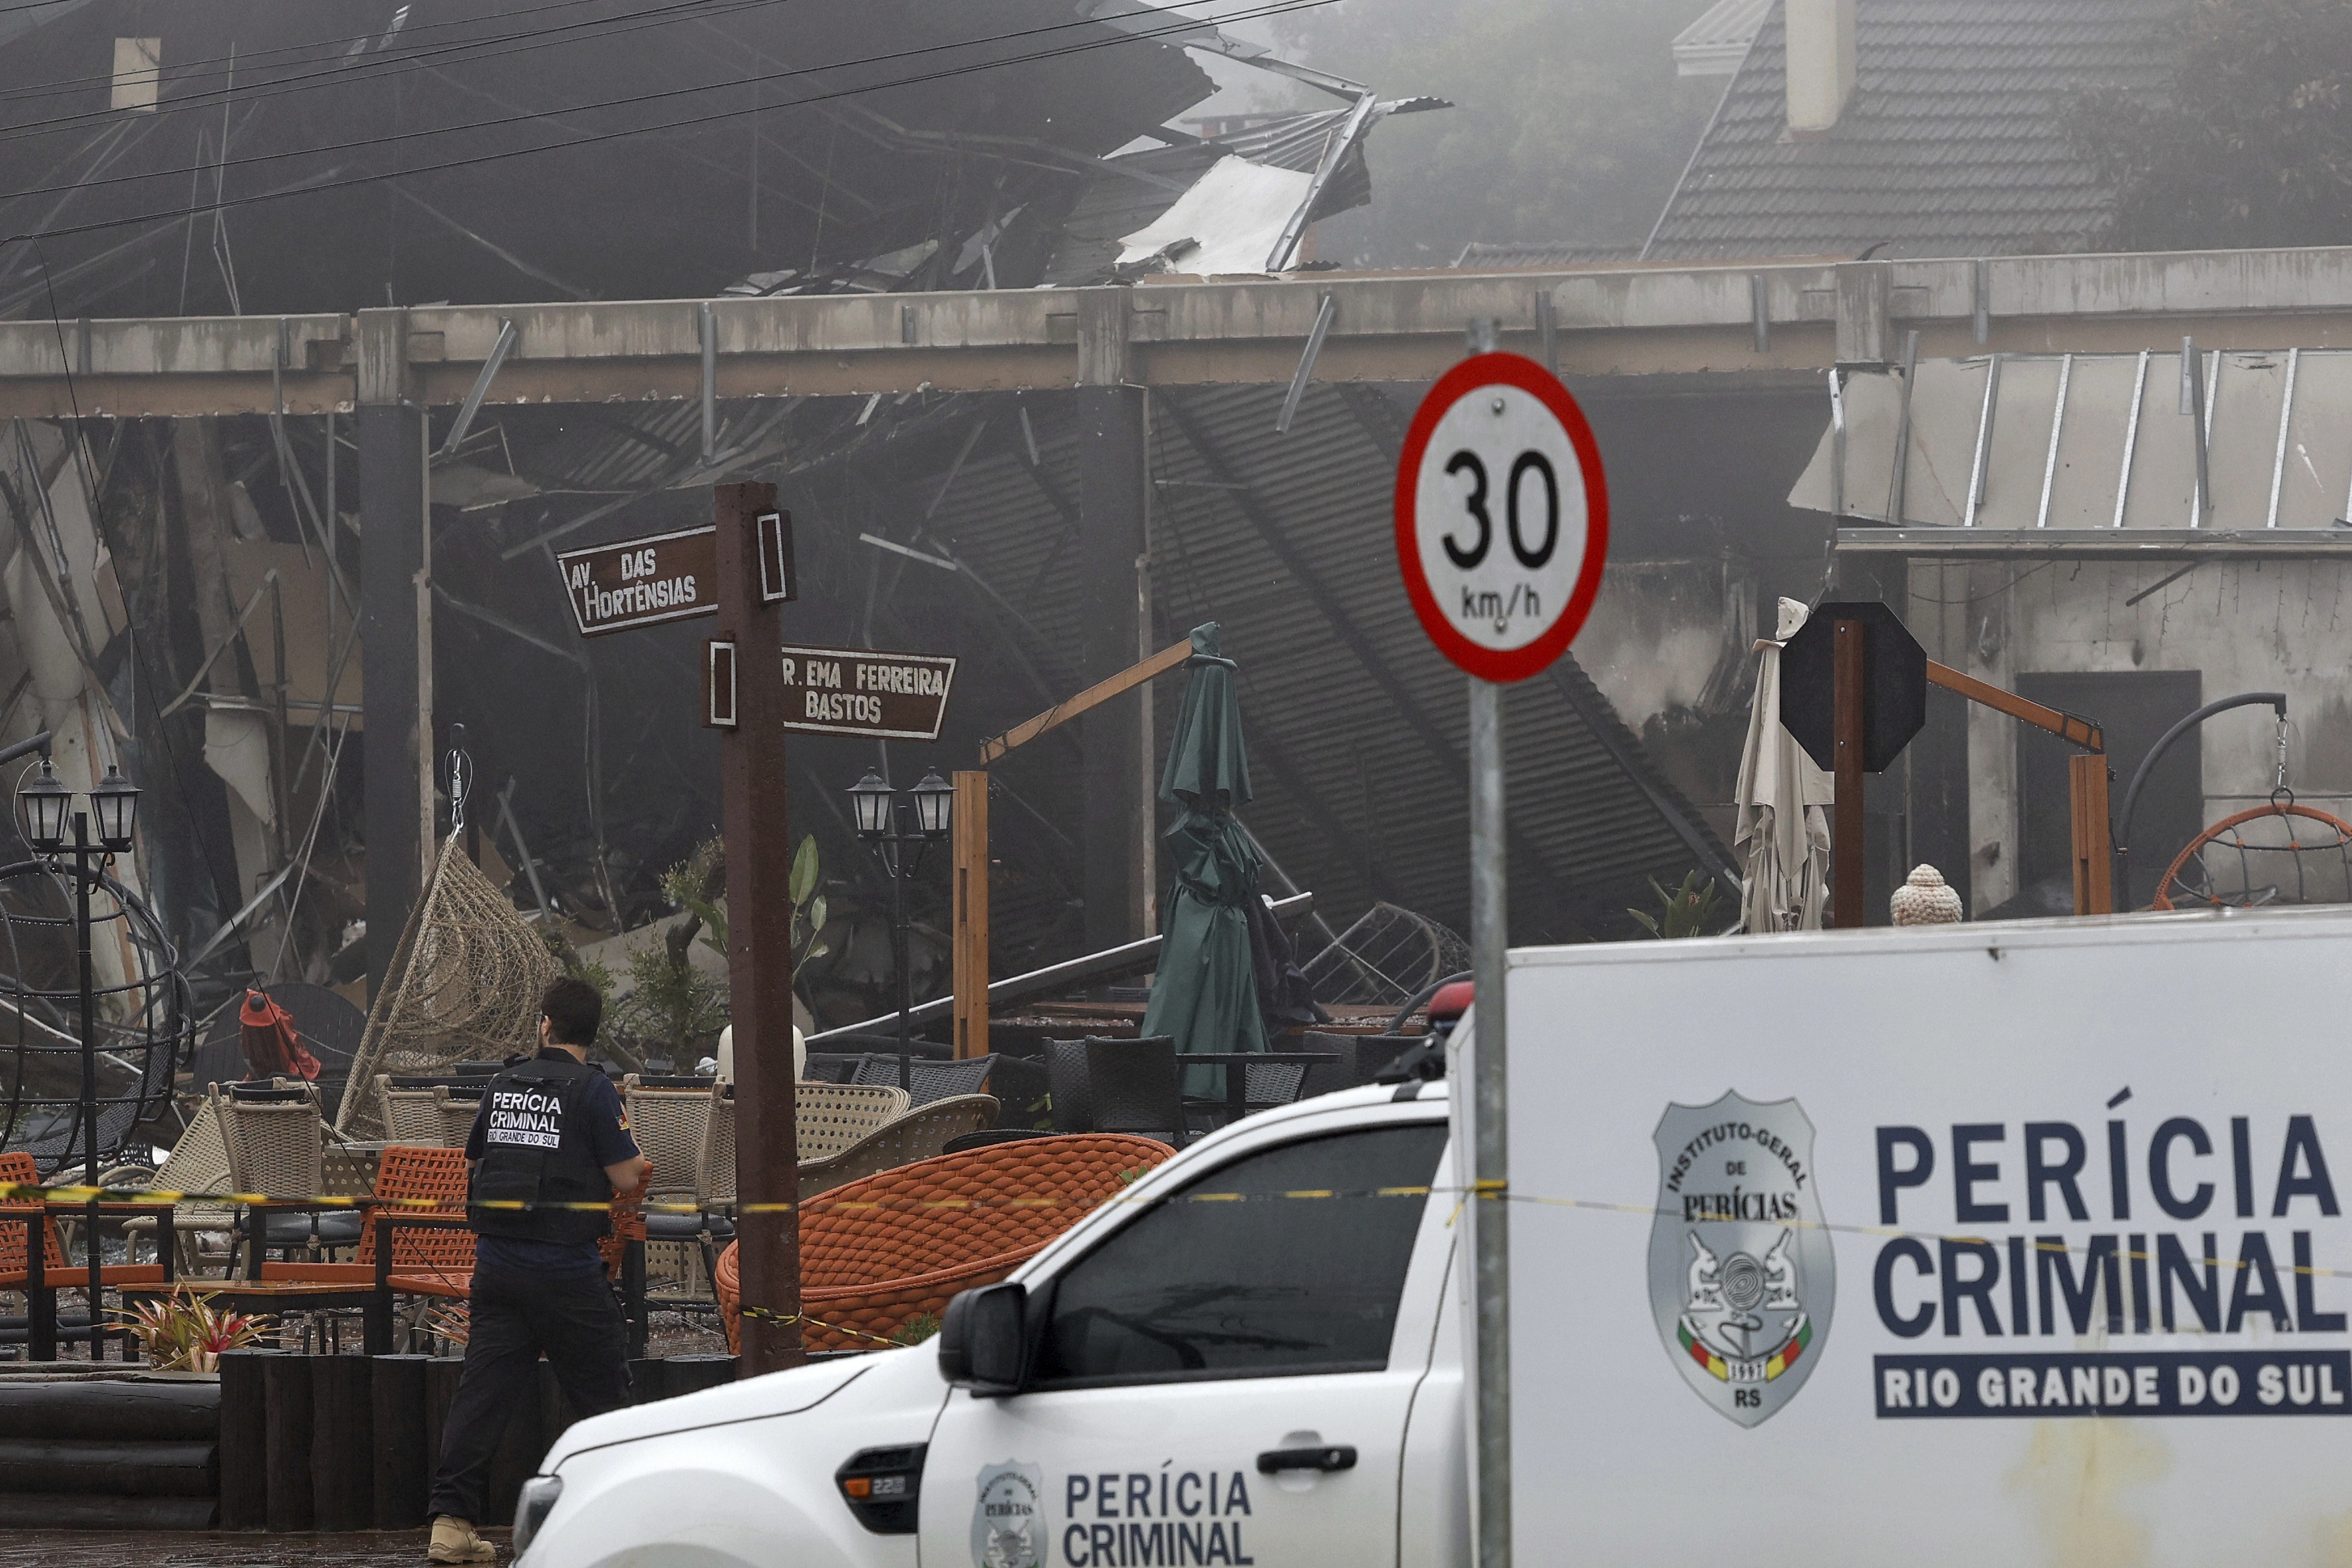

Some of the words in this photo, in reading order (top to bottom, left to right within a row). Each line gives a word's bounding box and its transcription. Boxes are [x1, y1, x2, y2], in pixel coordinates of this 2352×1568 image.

[1442, 448, 1561, 572] 30
[571, 562, 596, 589] AV.
[621, 548, 656, 581] DAS
[583, 575, 697, 621] HORTÊNSIAS
[1461, 583, 1541, 619] km/h
[782, 658, 803, 686] R.
[806, 660, 842, 689] EMA
[856, 663, 945, 697] FERREIRA
[805, 690, 882, 724] BASTOS
[492, 1087, 562, 1115] PERÍCIA
[490, 1110, 560, 1133] CRIMINAL
[499, 1131, 526, 1142] GRANDE
[528, 1133, 540, 1144] DO
[542, 1135, 557, 1146] SUL
[1725, 1161, 1746, 1176] DE
[1875, 1085, 2342, 1226] PERÍCIA
[1683, 1185, 1797, 1222] PERÍCIAS
[1873, 1231, 2348, 1339] CRIMINAL
[1735, 1389, 1761, 1408] RS
[1883, 1368, 1960, 1408] RIO
[1977, 1367, 2159, 1407] GRANDE
[2178, 1366, 2240, 1405] DO
[2257, 1364, 2343, 1405] SUL
[1066, 1458, 1252, 1518] PERÍCIA
[1063, 1521, 1255, 1568] CRIMINAL
